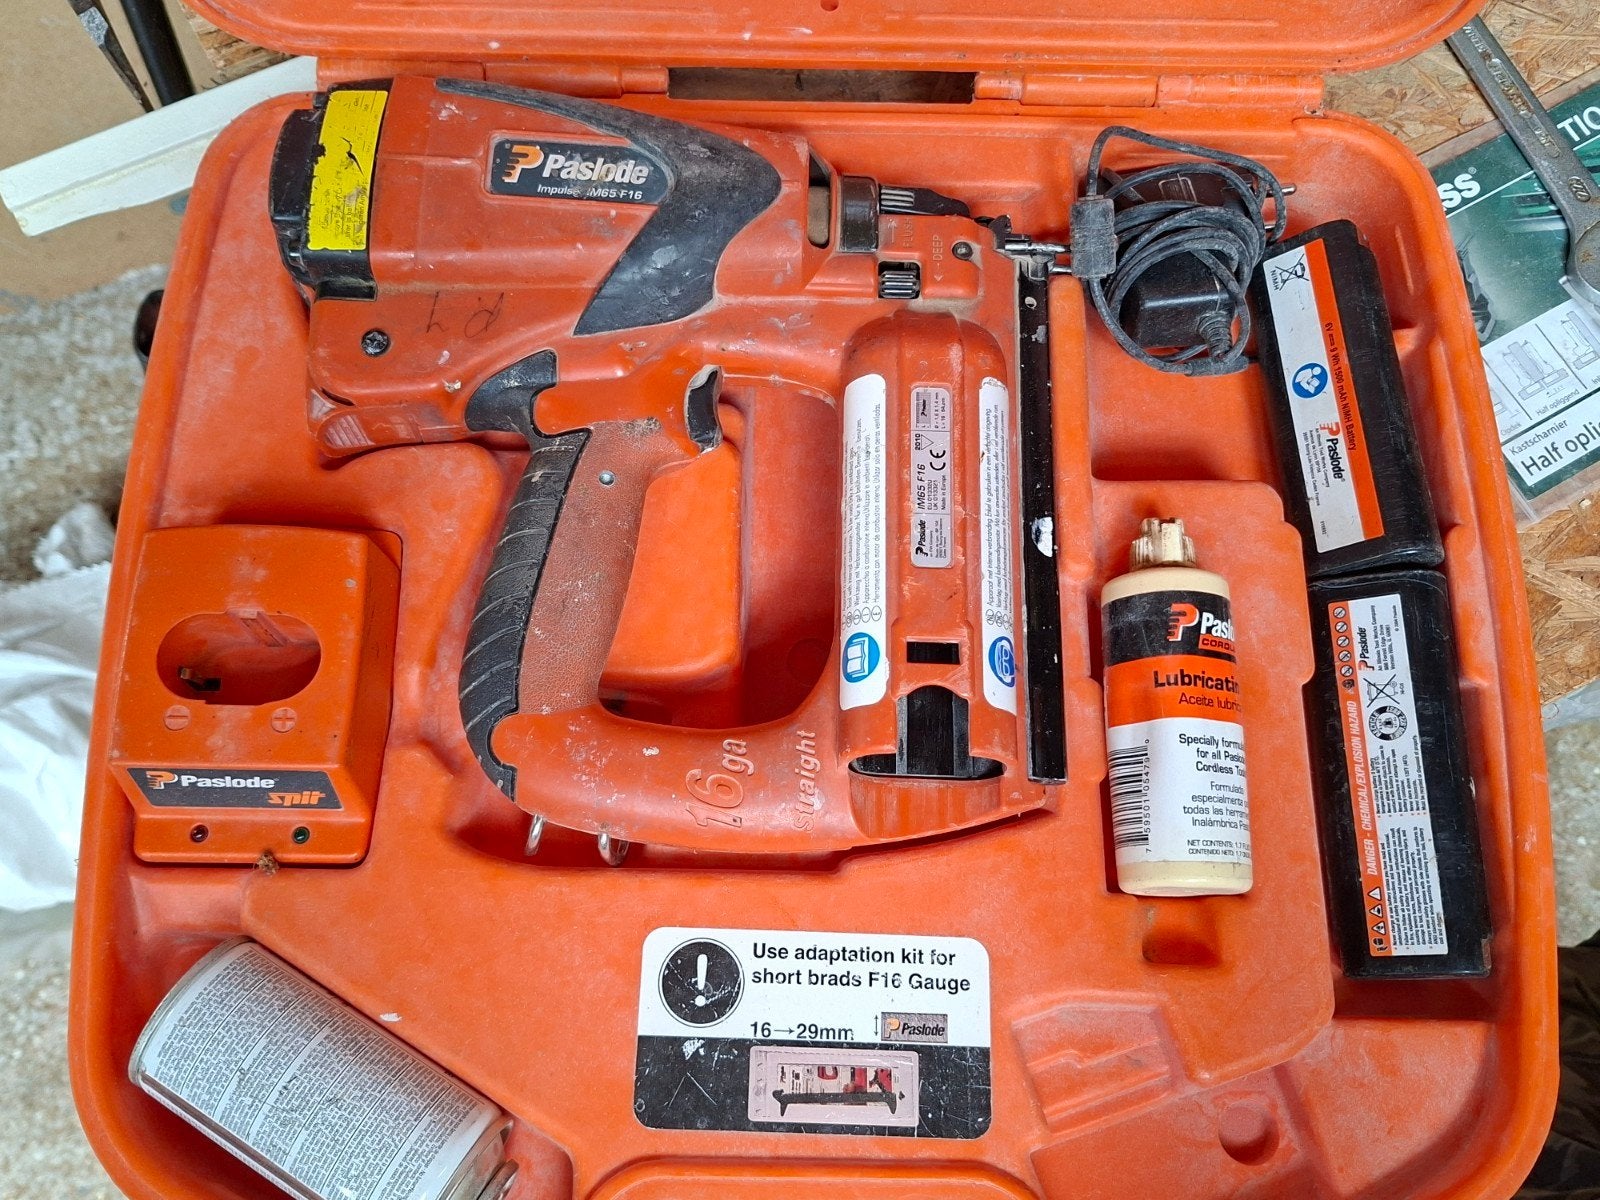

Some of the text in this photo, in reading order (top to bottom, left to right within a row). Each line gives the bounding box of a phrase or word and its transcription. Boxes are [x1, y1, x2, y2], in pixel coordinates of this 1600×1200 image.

[542, 153, 649, 186] Paslode
[620, 190, 643, 201] F16
[902, 217, 914, 249] FLUSH
[932, 234, 944, 261] DEEP
[1324, 322, 1333, 331] 6V
[1330, 353, 1340, 365] Wh
[1333, 366, 1344, 383] 1500
[1336, 384, 1348, 402] mAh
[1536, 389, 1580, 416] Half opliggend
[1343, 424, 1358, 451] Battery
[1509, 419, 1568, 456] Kastscharnier
[929, 449, 947, 471] CE
[1325, 437, 1346, 480] Paslode
[1521, 441, 1563, 476] Half
[917, 463, 926, 510] IM65 F16
[917, 519, 926, 546] Paslode
[1369, 604, 1378, 624] Company
[1356, 626, 1369, 659] Paslode
[1179, 692, 1214, 708] Aceite
[1346, 701, 1361, 735] HAZARD
[1370, 711, 1381, 737] RECYCLE
[1179, 733, 1219, 750] Specially
[1196, 747, 1210, 759] for
[1211, 750, 1221, 761] all
[794, 731, 822, 831] Straight
[1142, 757, 1151, 791] 05479
[1196, 761, 1234, 775] Cordless
[181, 775, 276, 789] Paslode
[1352, 737, 1373, 831] CHEMICAL/EXPLOSION
[267, 791, 326, 807] spit
[1183, 804, 1210, 815] todas
[1212, 805, 1224, 816] las
[1142, 799, 1151, 833] 59501
[1187, 839, 1200, 847] NET
[1202, 839, 1234, 849] CONTENTS:
[1363, 839, 1378, 876] DANGER
[753, 942, 956, 967] Use adaptation kit for
[751, 968, 971, 995] short brads F16 Gauge
[901, 1022, 946, 1038] Paslode
